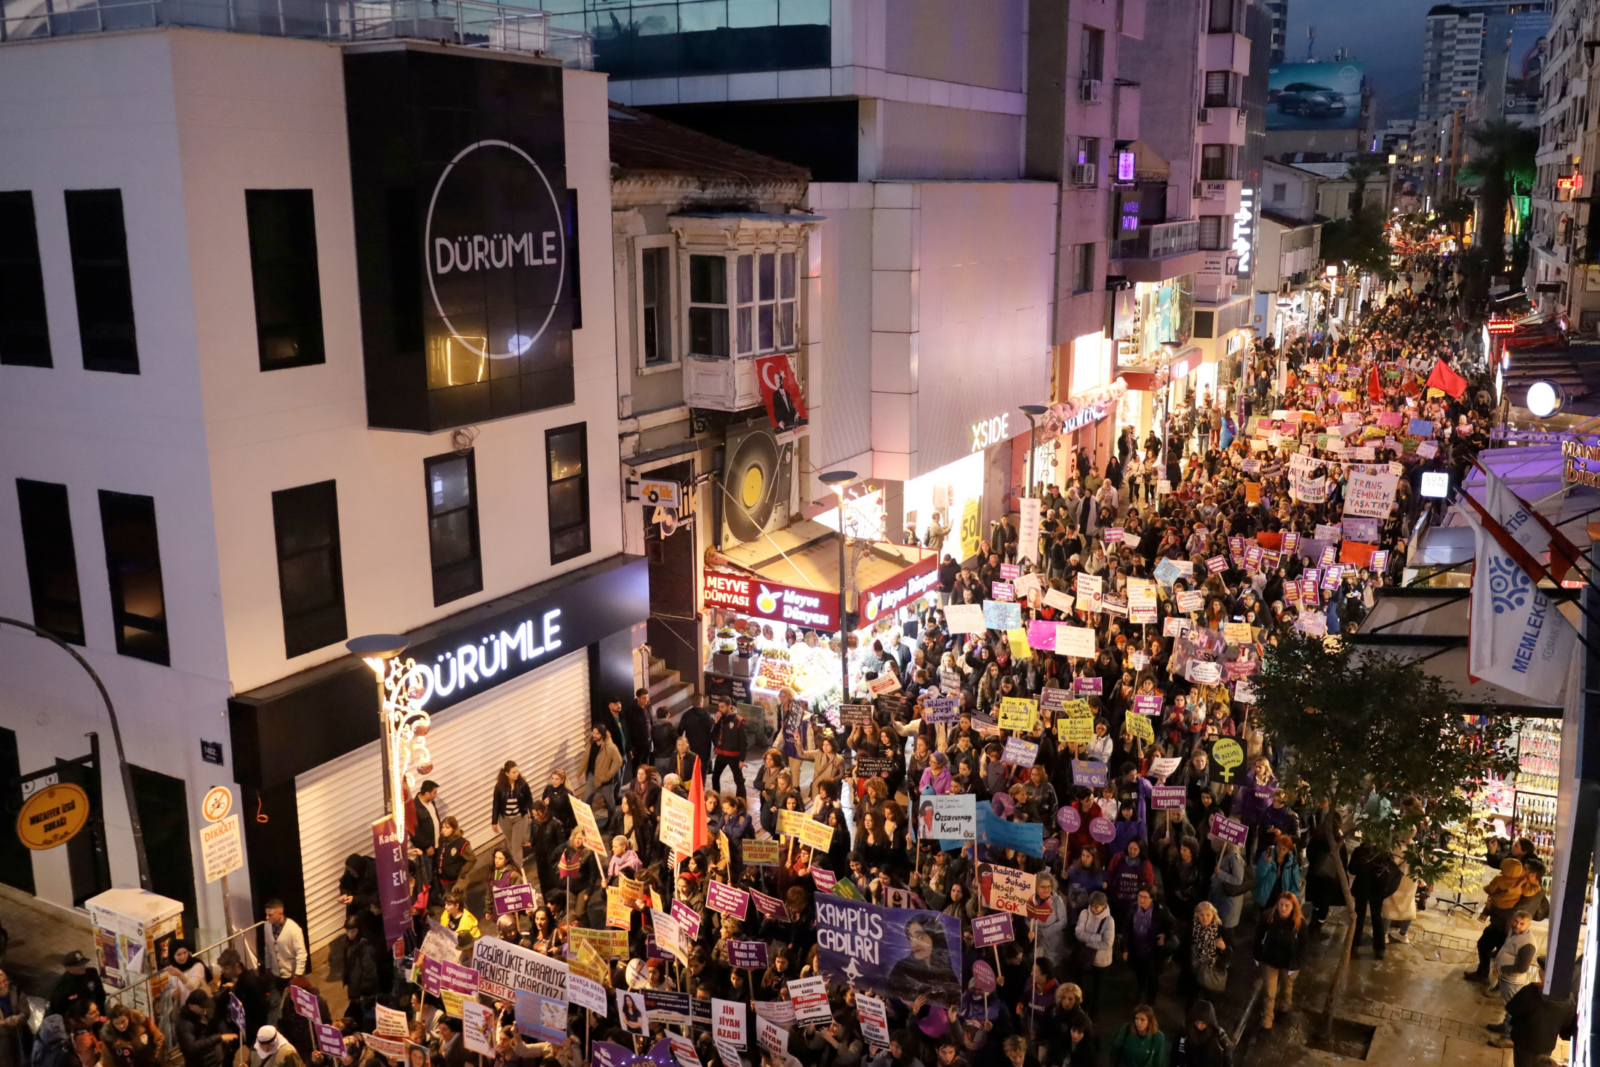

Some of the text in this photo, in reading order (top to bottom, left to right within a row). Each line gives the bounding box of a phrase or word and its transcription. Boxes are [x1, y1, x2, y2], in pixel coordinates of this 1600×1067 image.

[435, 231, 557, 274] DÜRÜMLE
[972, 412, 1009, 453] XSIDE
[1354, 479, 1382, 490] TRANS
[1354, 508, 1382, 516] LAVENDER
[706, 576, 749, 594] MEYVE
[880, 569, 939, 610] Meyve Dünyası
[704, 590, 750, 607] DÜNYASI
[783, 588, 820, 610] Meyve
[783, 604, 830, 626] Dünyası
[409, 608, 562, 710] DÜRÜMLE
[1152, 788, 1185, 797] ÖZSAVUNMA
[204, 820, 236, 842] DİKKAT!
[940, 823, 962, 834] Kuşan!
[994, 866, 1023, 879] Kadınlar
[992, 882, 1014, 894] Hesap
[1005, 877, 1031, 891] Sokağa
[996, 896, 1020, 913] ÖGK
[816, 902, 883, 940] KAMPÜS
[817, 928, 880, 966] CADILARI
[476, 940, 566, 990] ÖZGÜRLÜKTE KARARLIYIZ
[568, 975, 605, 995] SAVAŞA HAYIR
[569, 983, 581, 993] BARIŞ
[581, 988, 594, 998] HEMEN
[722, 1005, 734, 1015] JİN
[718, 1016, 740, 1028] JİYAN
[766, 1024, 777, 1035] JİN
[762, 1032, 782, 1045] JİYAN
